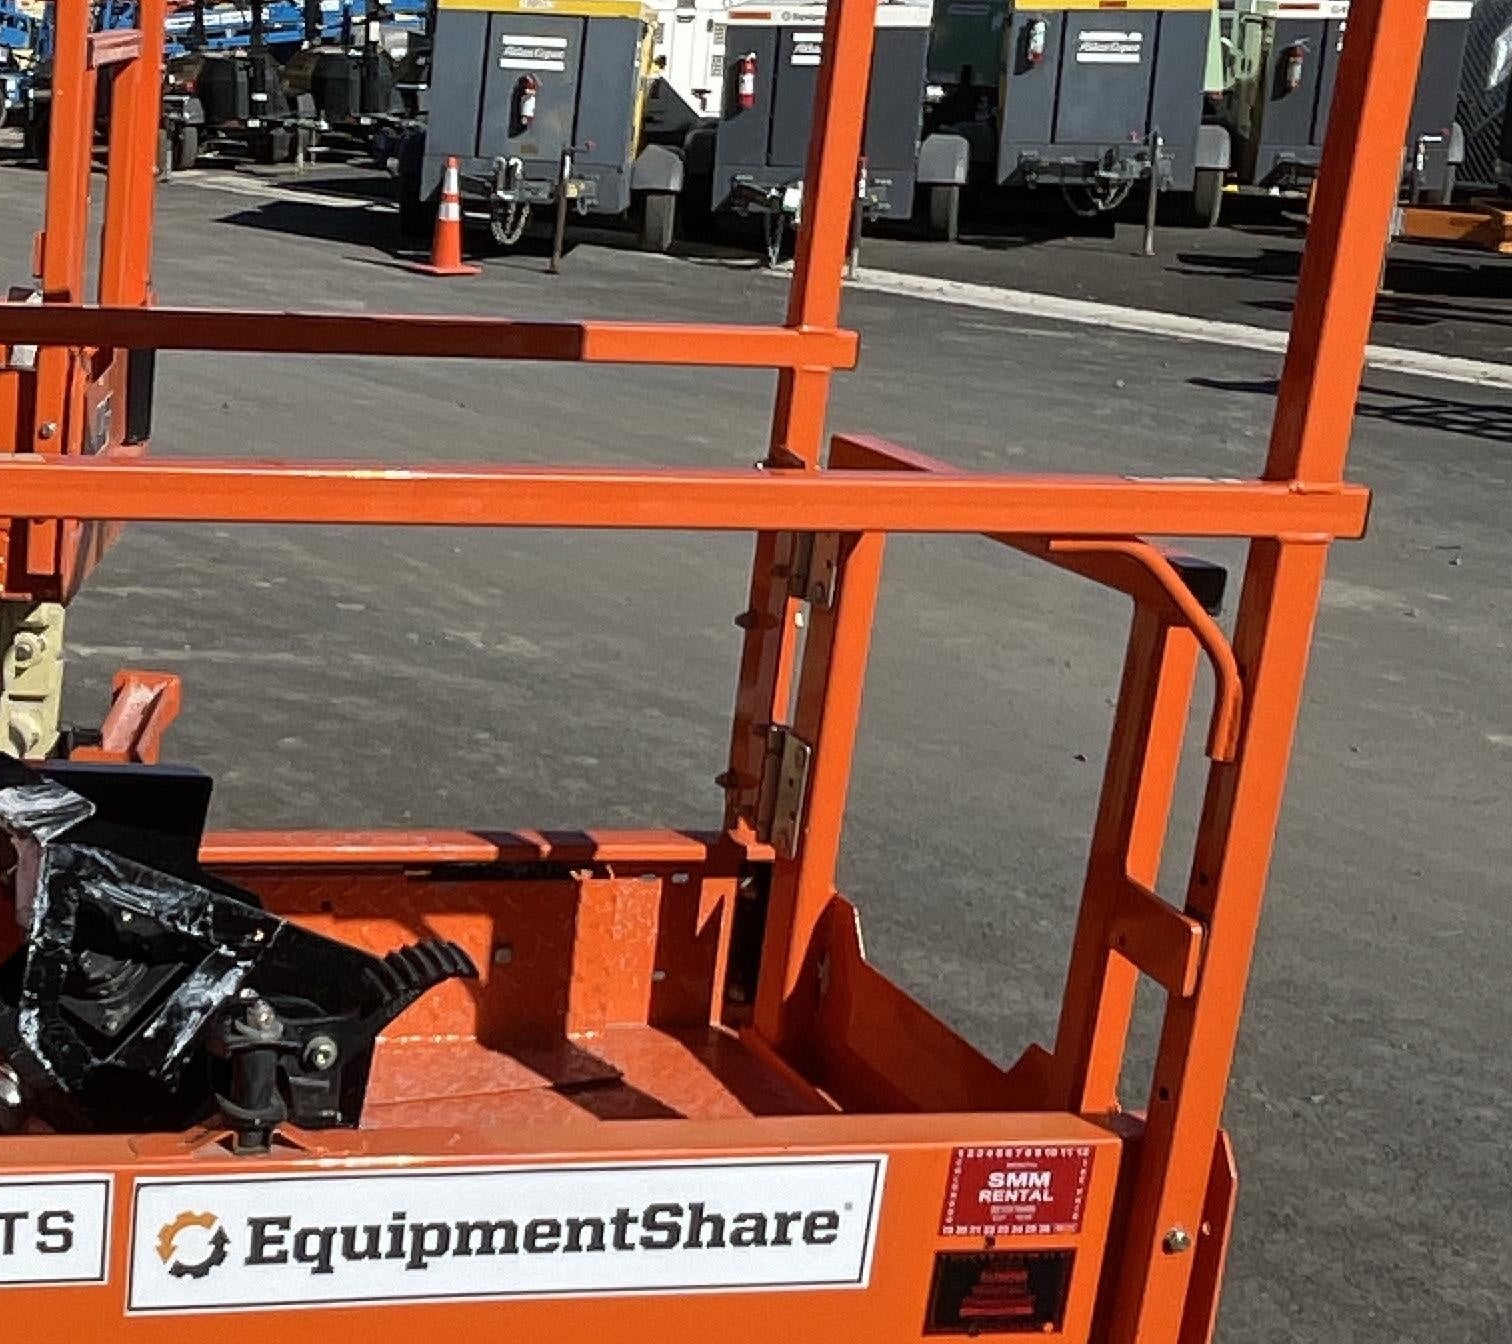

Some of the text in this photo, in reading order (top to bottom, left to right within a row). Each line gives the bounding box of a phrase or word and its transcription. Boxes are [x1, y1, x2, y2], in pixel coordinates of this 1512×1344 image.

[989, 1172, 1051, 1188] SMM
[978, 1189, 1053, 1203] RENTAL
[244, 1203, 840, 1275] EquipmentShare
